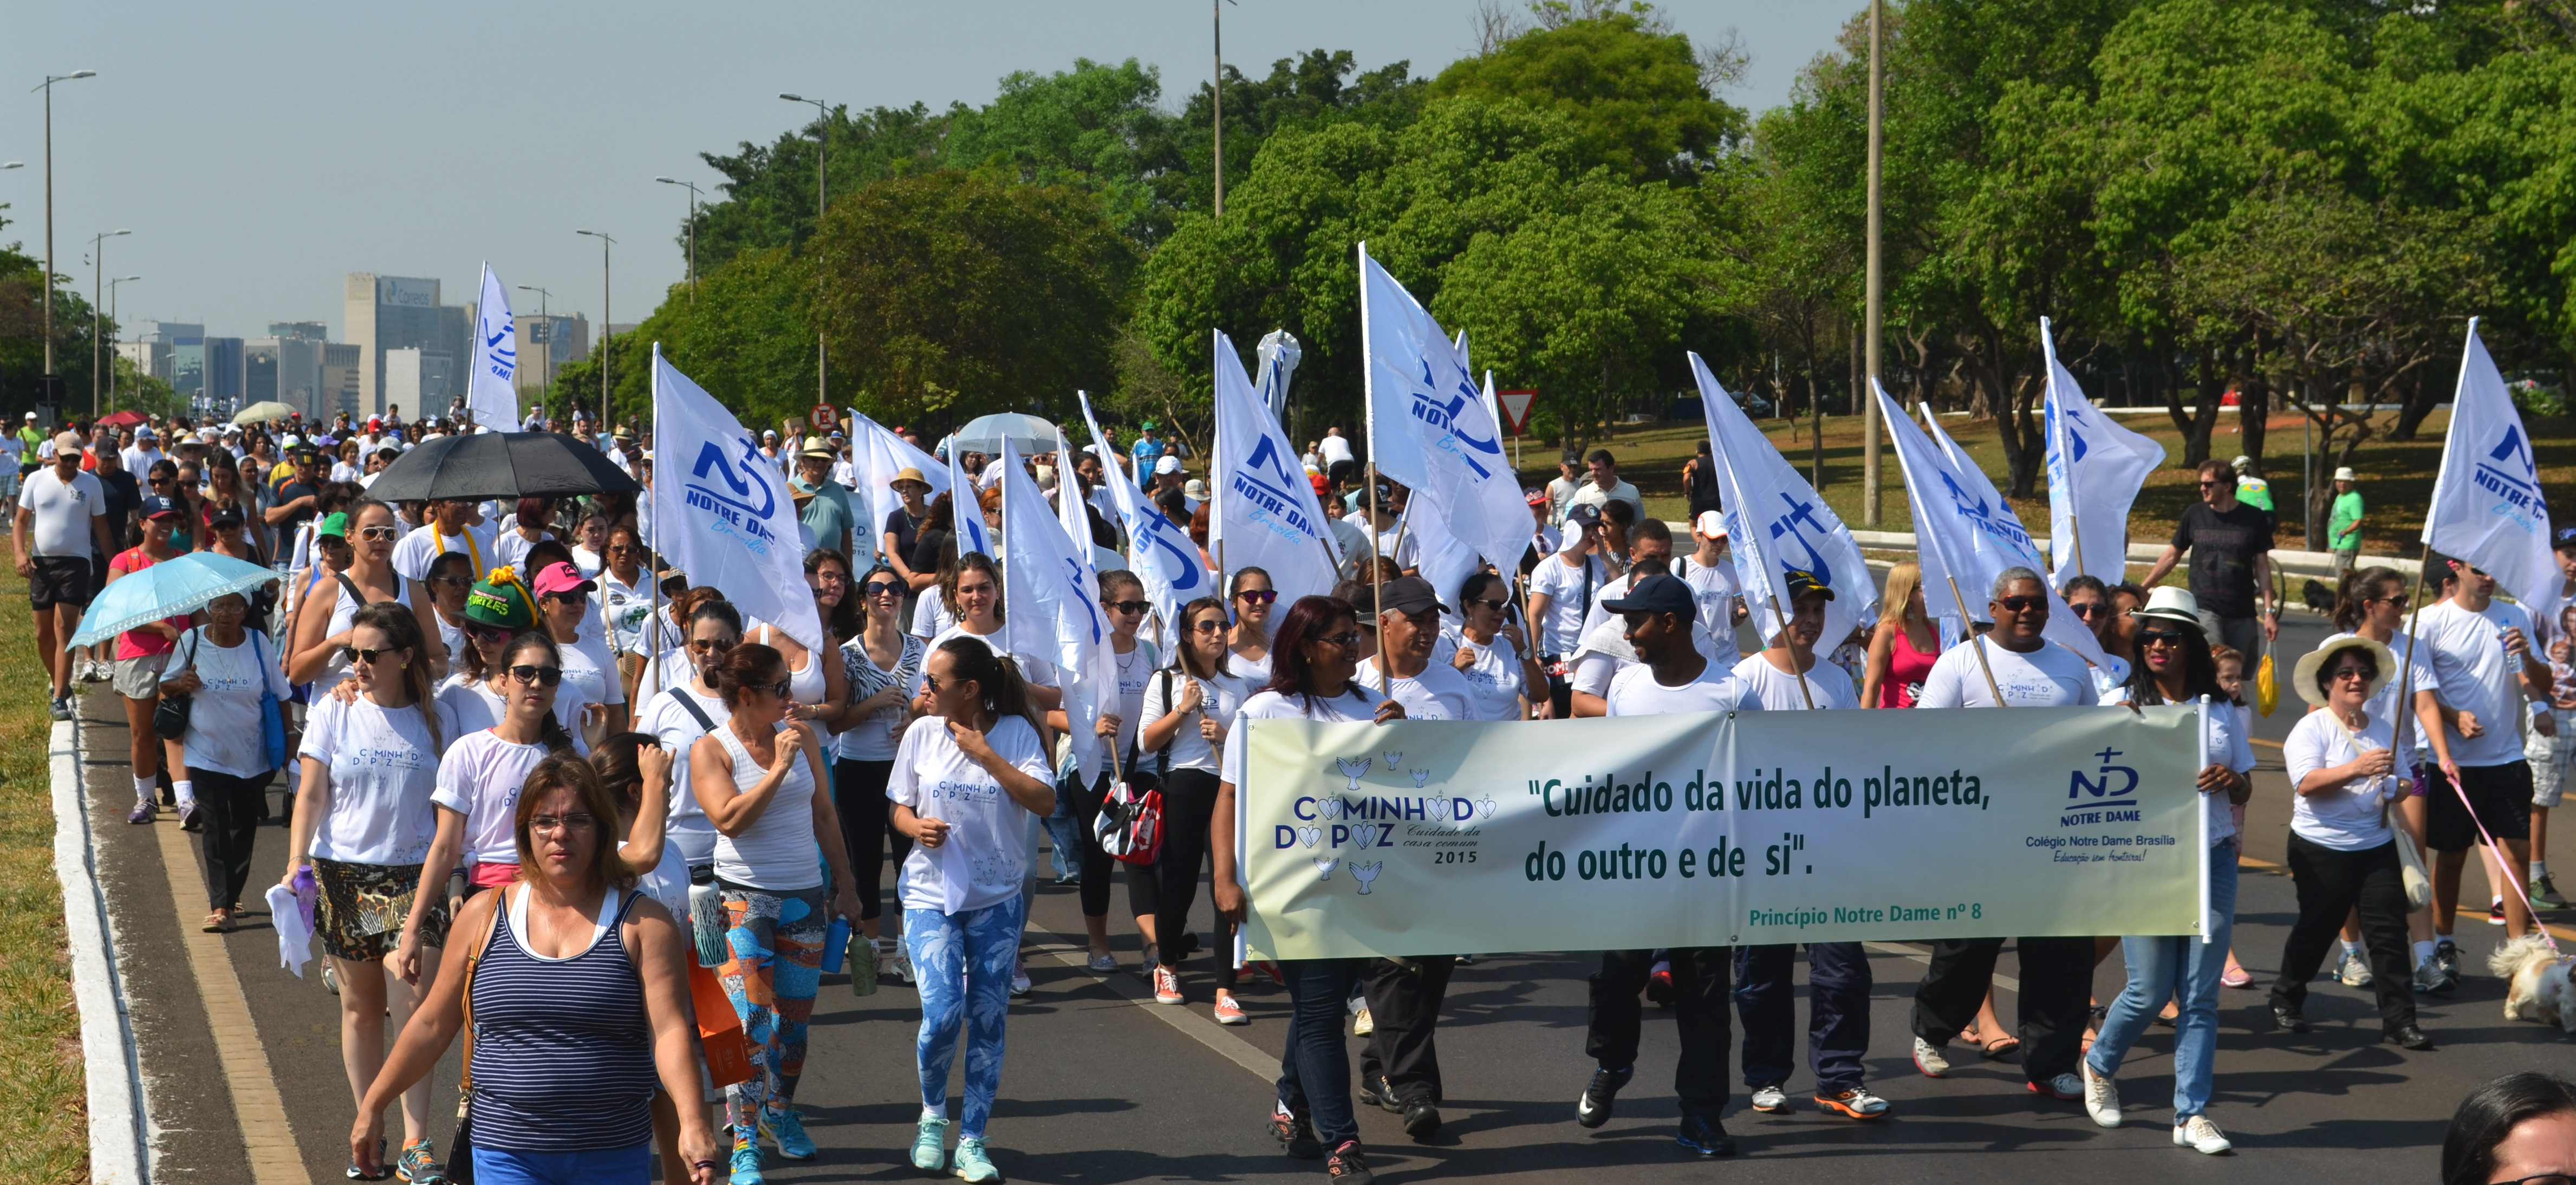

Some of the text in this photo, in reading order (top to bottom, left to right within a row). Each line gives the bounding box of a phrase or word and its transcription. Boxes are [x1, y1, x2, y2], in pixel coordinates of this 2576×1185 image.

[398, 289, 429, 307] Correios
[490, 364, 512, 381] AME
[1412, 400, 1458, 439] NOT
[2474, 468, 2532, 510] NOTRE
[686, 490, 775, 545] NOTRE DA
[1234, 476, 1317, 540] NOTRE DAM
[468, 595, 509, 616] TURTLES
[1528, 765, 1990, 818] "Cuidado da vida do planeta,
[1293, 794, 1497, 822] CMINHD
[2060, 810, 2141, 828] NOTRE DAME
[1331, 820, 1396, 850] PZ
[1406, 824, 1460, 837] Cuidado
[1464, 828, 1481, 837] da
[1403, 839, 1478, 848] casa comum
[2026, 835, 2176, 849] Colégio Notre Dame Brasília
[1434, 851, 1478, 864] 2015
[1525, 832, 1812, 881] do outro e de si".
[2053, 850, 2090, 864] Educação
[2108, 849, 2147, 862] fronteiras!
[1749, 903, 1982, 929] Princípio Notre Dame nº 8
